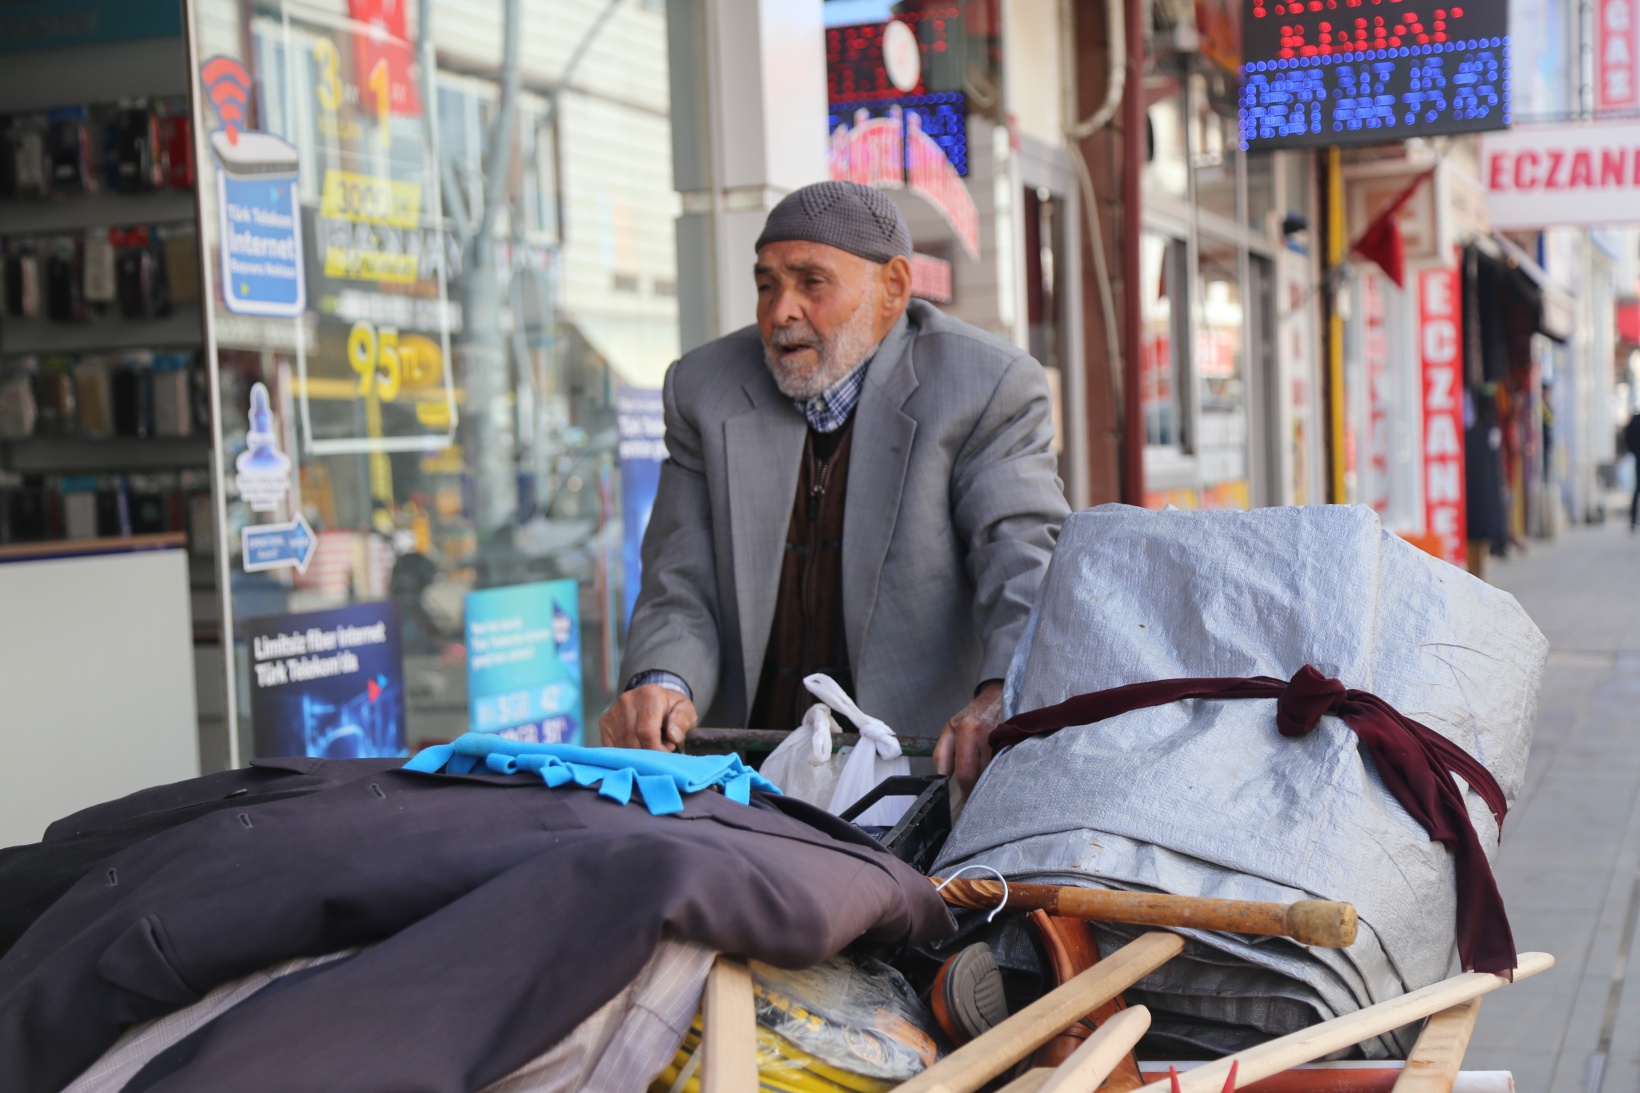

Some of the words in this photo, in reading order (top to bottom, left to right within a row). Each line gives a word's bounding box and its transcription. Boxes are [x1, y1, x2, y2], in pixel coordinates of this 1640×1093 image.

[348, 321, 401, 402] 95
[254, 631, 306, 661] Limitsiz
[306, 628, 337, 653] fiber
[337, 620, 387, 648] internet
[254, 660, 288, 688] Türk
